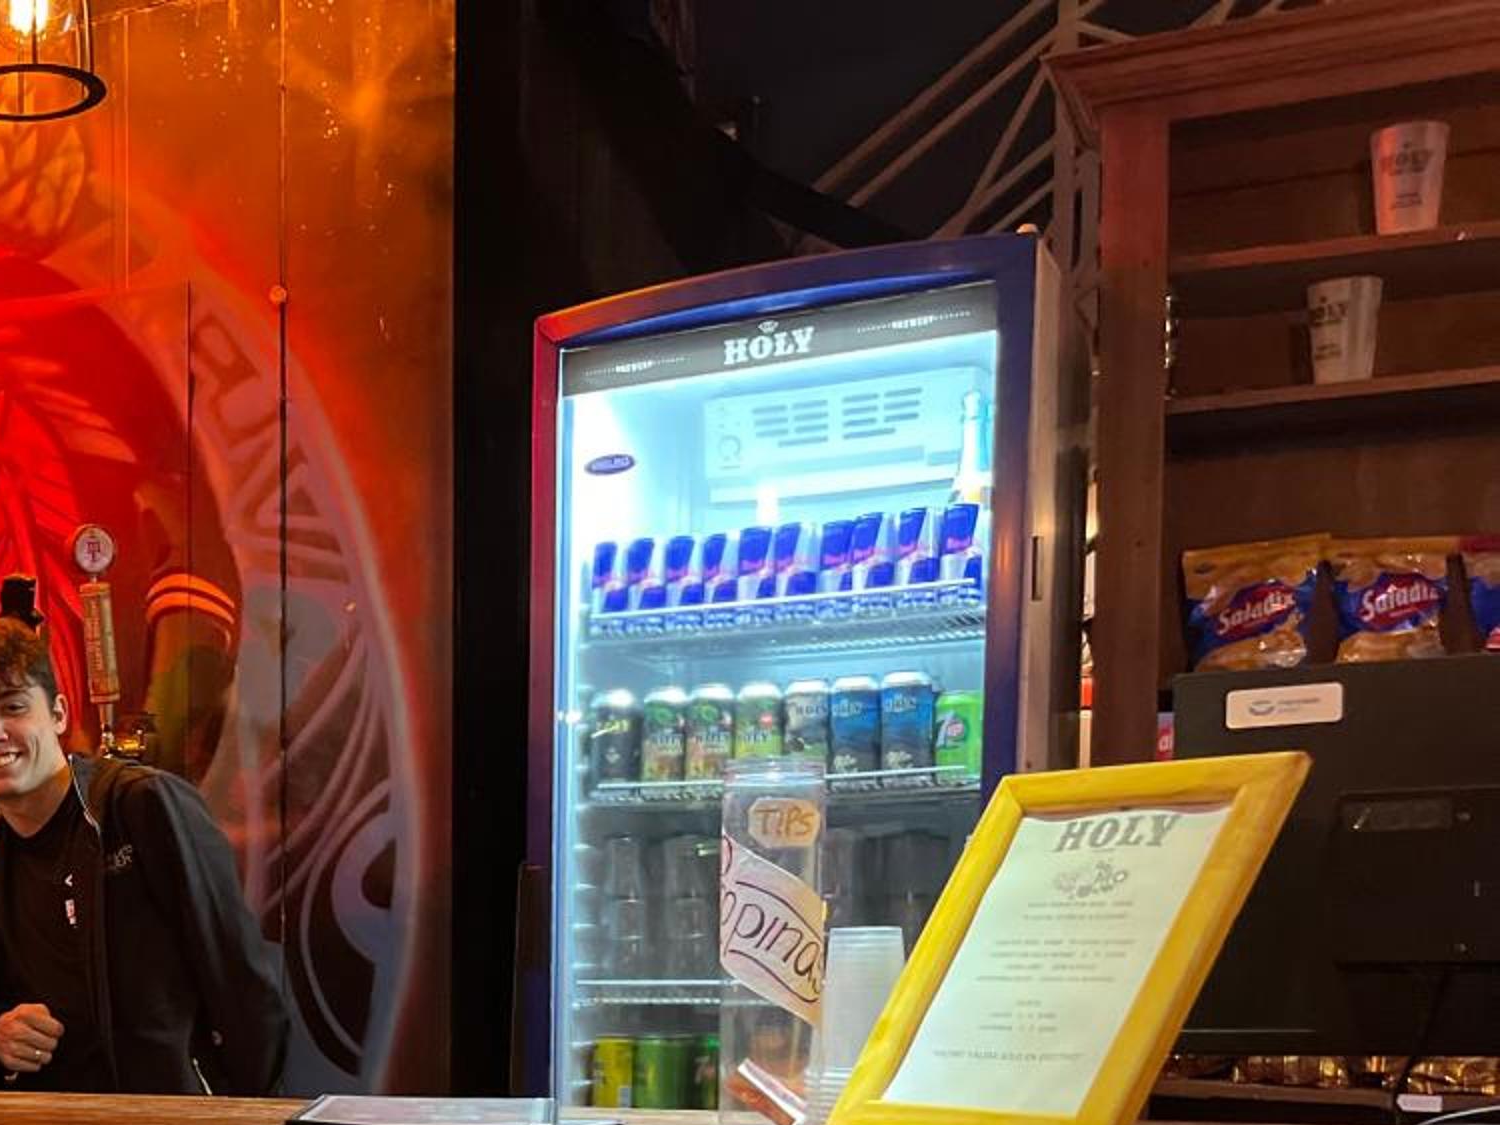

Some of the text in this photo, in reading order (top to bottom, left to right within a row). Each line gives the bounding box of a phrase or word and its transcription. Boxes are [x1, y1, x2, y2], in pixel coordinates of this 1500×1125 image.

[723, 326, 815, 366] HOLY
[1216, 590, 1298, 637] Saladix
[752, 806, 816, 838] TIPS
[1052, 813, 1184, 853] HOLY
